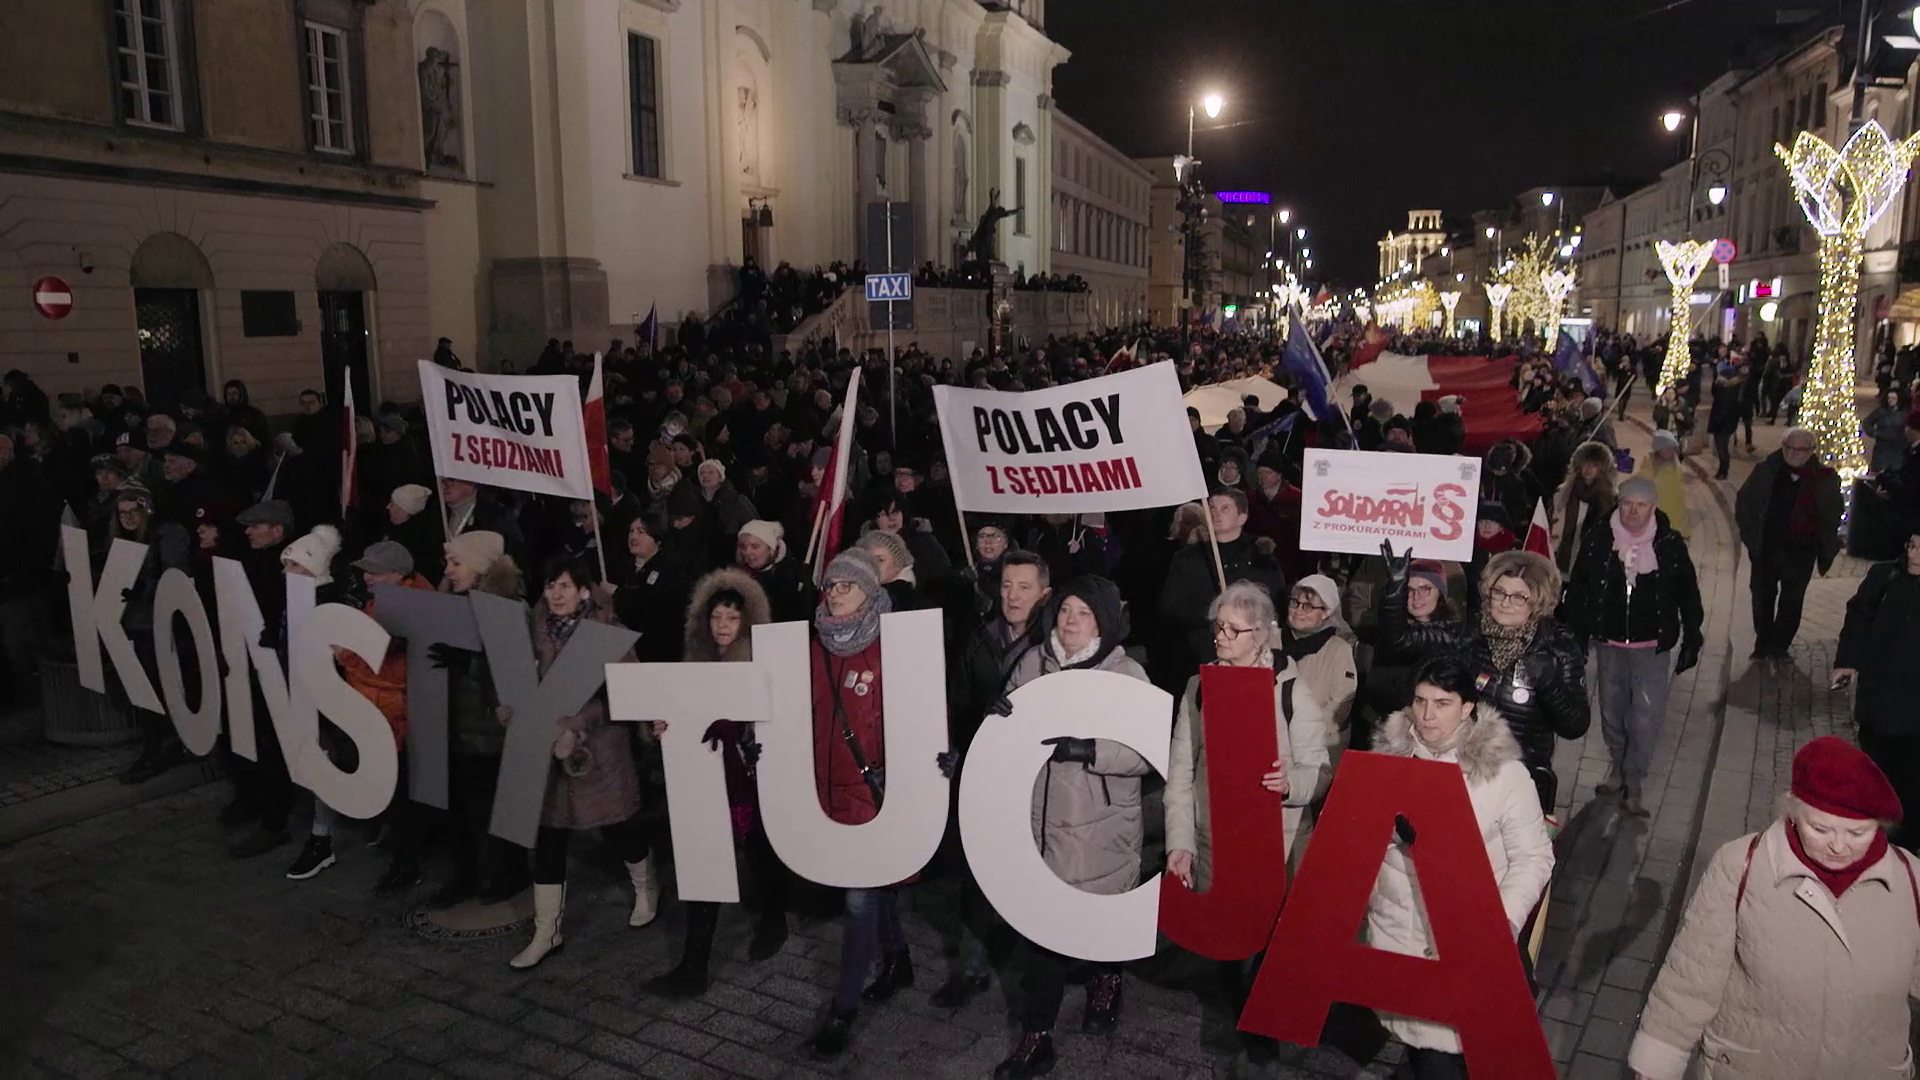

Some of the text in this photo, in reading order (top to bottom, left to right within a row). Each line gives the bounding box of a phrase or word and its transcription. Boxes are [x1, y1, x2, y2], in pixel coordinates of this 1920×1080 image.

[867, 276, 909, 298] TAXI
[444, 378, 555, 437] POLACY
[973, 393, 1124, 455] POLACY
[452, 432, 565, 479] Z SĘDZIAMI
[986, 456, 1142, 498] Z SĘDZIAMI
[1313, 521, 1427, 539] Z PROKURATORAMI
[61, 524, 1557, 1080] KONSTYTUCJA
